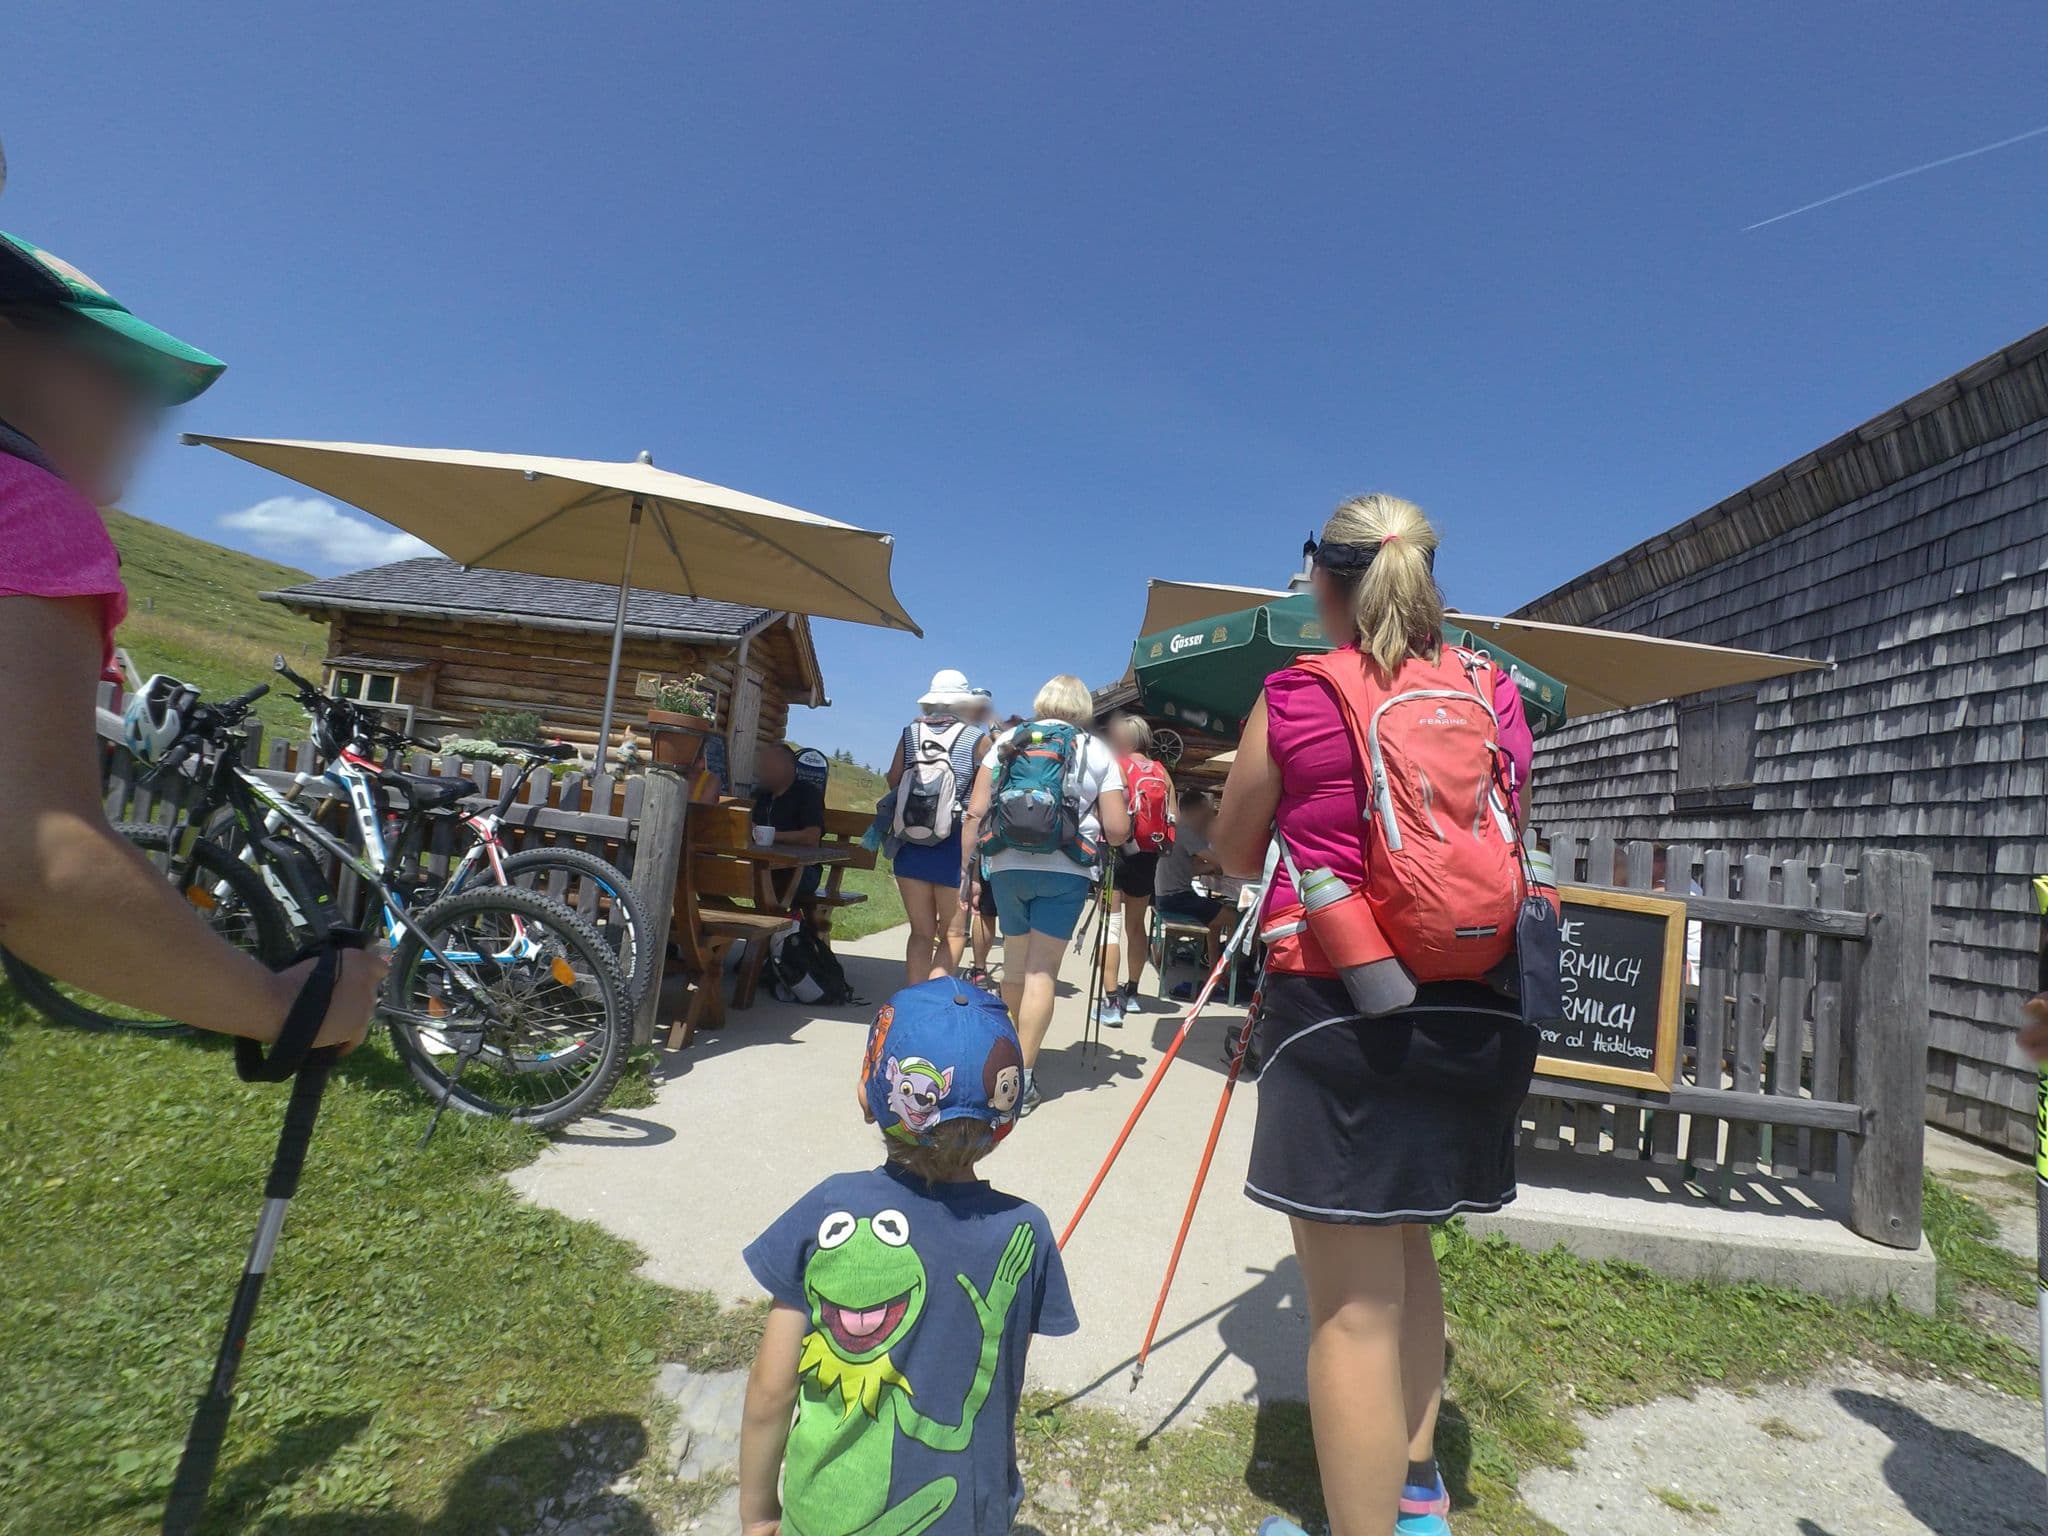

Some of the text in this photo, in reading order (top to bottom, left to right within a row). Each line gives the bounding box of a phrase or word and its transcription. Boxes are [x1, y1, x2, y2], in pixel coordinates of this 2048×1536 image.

[1559, 949, 1642, 987] RMILCH
[1561, 995, 1636, 1033] RMILCH
[1539, 1029, 1562, 1043] eer
[1592, 1031, 1654, 1059] Heidelbeer
